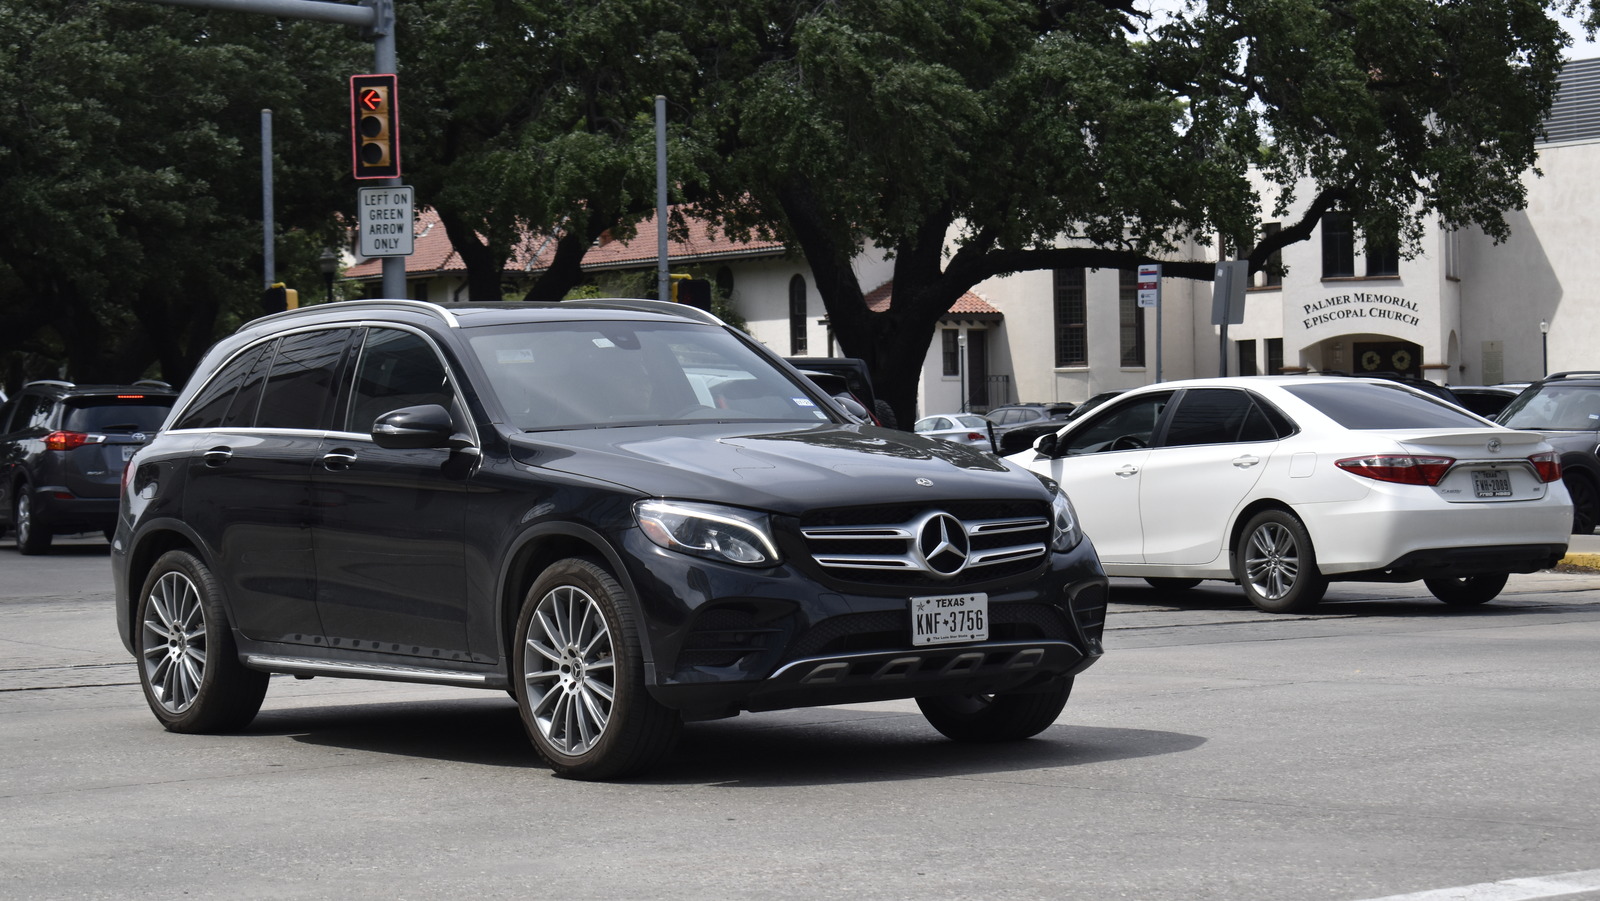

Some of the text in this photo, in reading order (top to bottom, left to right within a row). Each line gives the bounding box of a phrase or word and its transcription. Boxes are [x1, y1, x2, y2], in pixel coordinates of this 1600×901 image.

[364, 193, 408, 206] LEFT ON
[369, 208, 404, 220] GREEN
[369, 223, 404, 235] ARROW
[374, 238, 399, 250] ONLY
[1303, 292, 1419, 315] PALMER MEMORIAL
[1303, 307, 1420, 330] EPISCOPAL CHURCH
[935, 597, 965, 608] TEXAS
